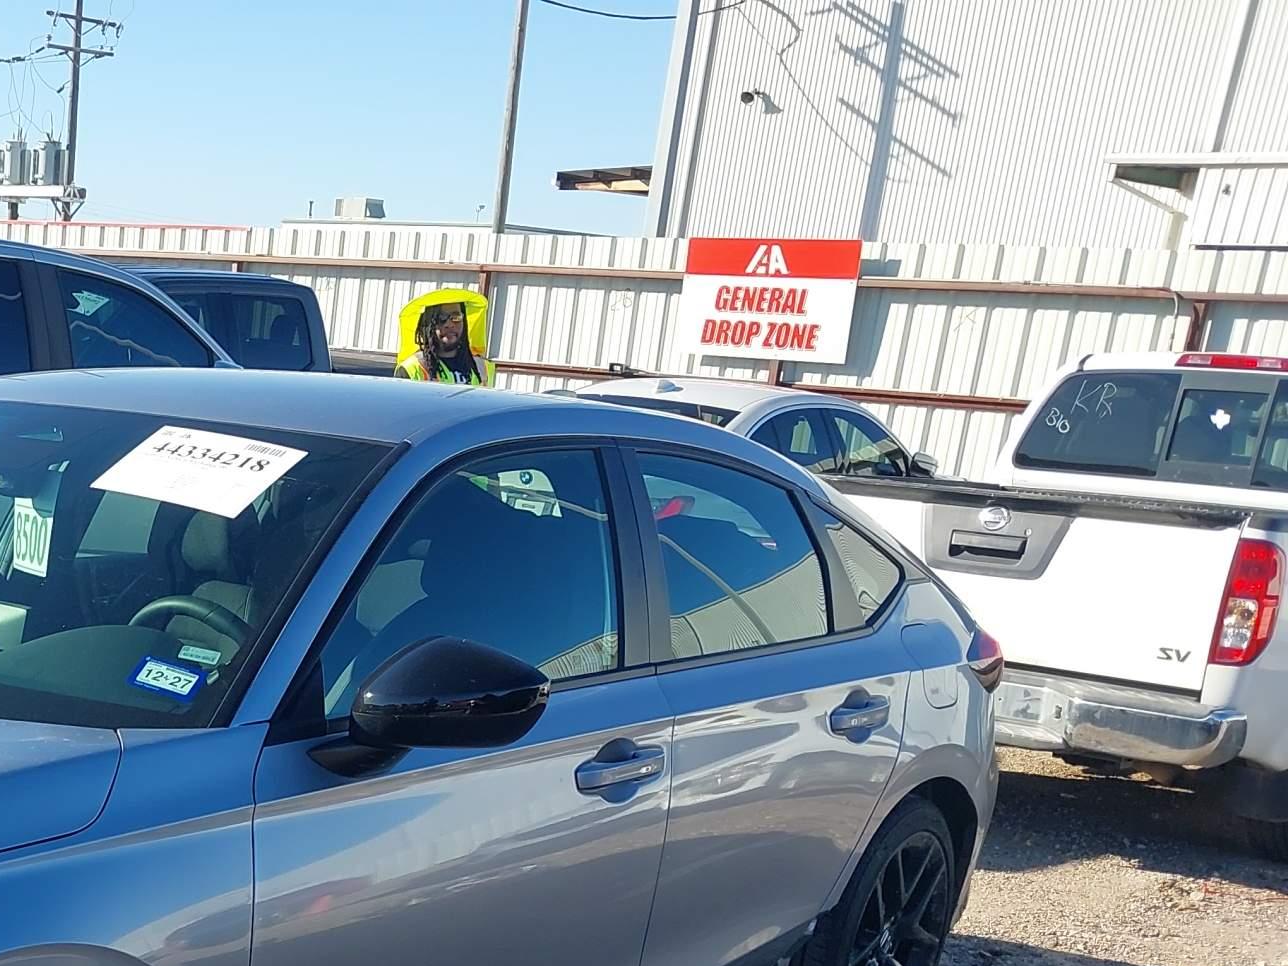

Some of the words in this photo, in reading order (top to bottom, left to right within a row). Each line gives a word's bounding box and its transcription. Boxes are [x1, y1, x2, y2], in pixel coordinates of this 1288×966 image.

[715, 285, 808, 316] GENERAL
[701, 319, 761, 347] DROP
[762, 322, 821, 351] ZONE
[153, 442, 270, 472] 44334218
[15, 511, 48, 566] 8500
[1156, 647, 1192, 663] SV
